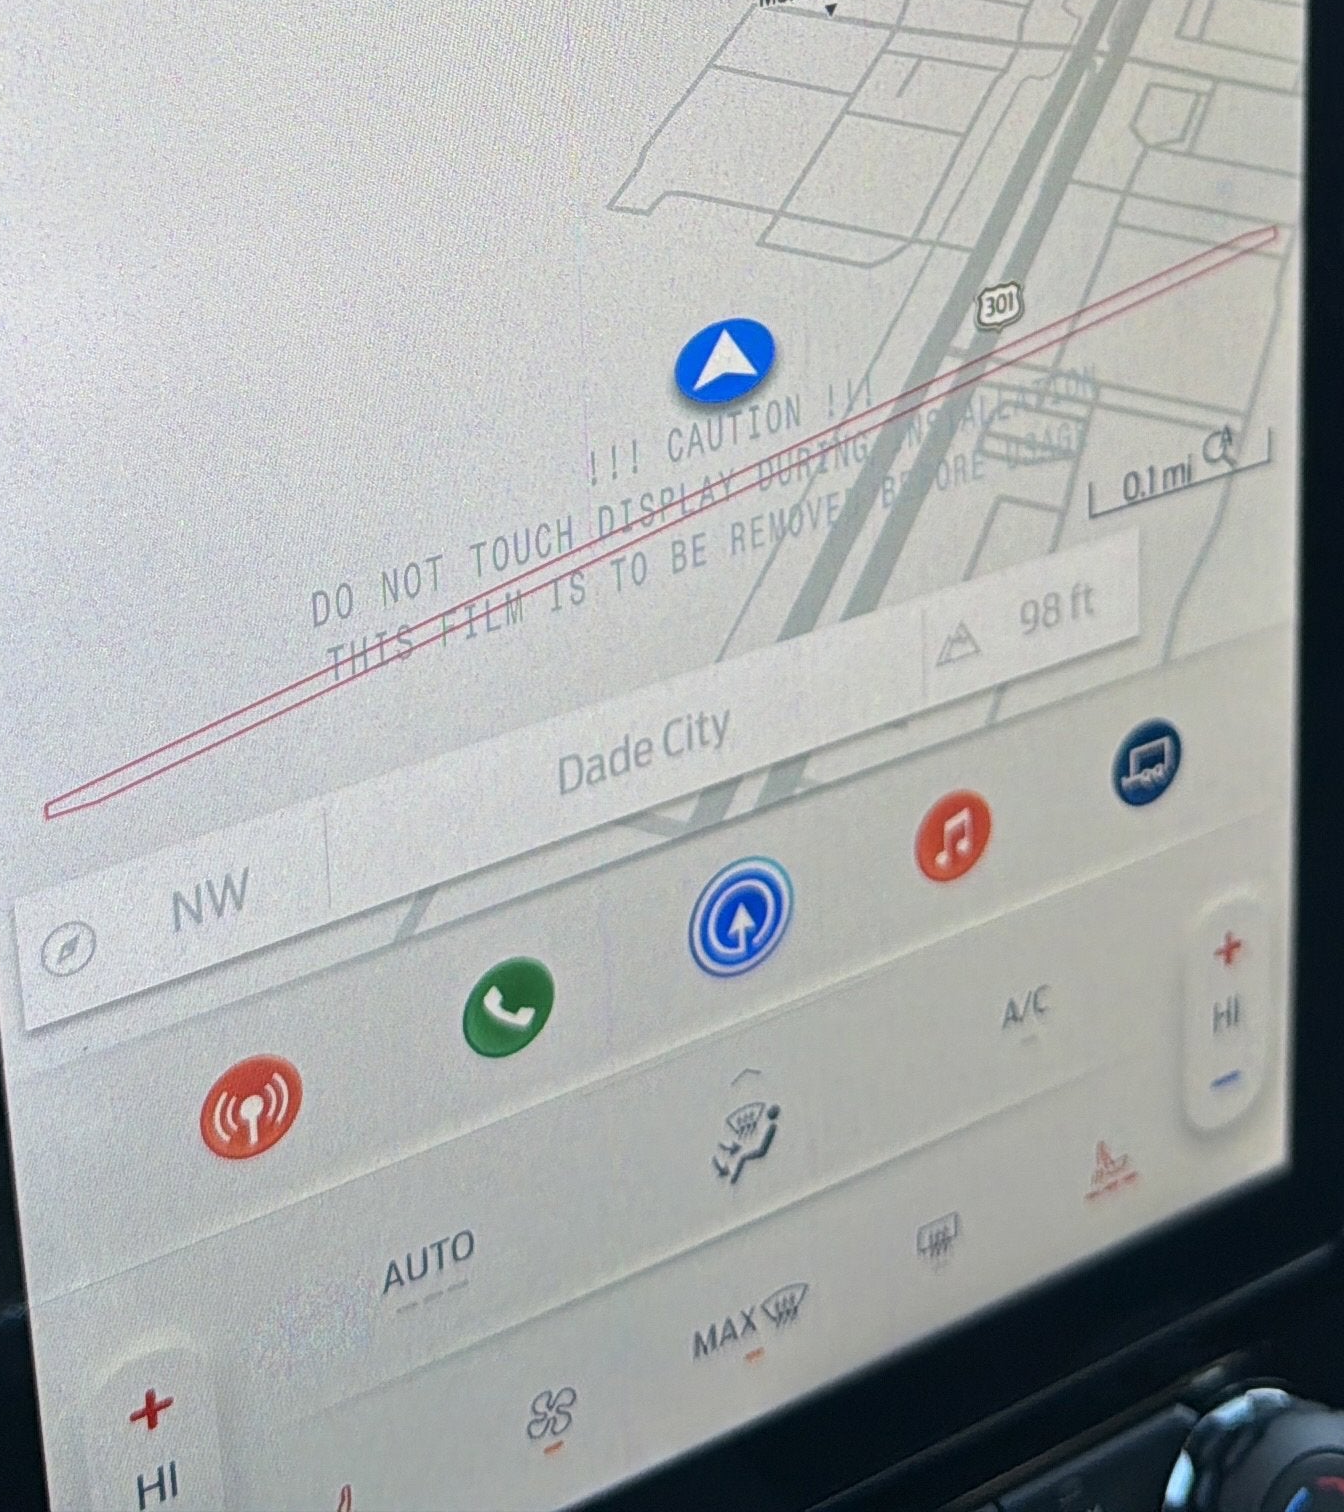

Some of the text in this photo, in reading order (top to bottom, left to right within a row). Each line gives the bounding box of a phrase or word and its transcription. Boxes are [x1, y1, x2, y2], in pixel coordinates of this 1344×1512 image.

[984, 291, 1016, 319] 301
[667, 394, 802, 464] CAUTION
[1122, 453, 1193, 502] 0.1 mi
[311, 582, 354, 628] DO
[381, 554, 444, 607] NOT
[469, 515, 575, 578] TOUCH
[598, 467, 736, 538] DISPLAY
[758, 432, 871, 493] DURING
[326, 624, 414, 682] THIS
[440, 589, 524, 648] FILM
[550, 571, 587, 612] IS
[610, 550, 648, 592] TO
[671, 531, 707, 574] BE
[730, 488, 859, 556] REMOVE
[1019, 582, 1096, 638] 98 ft
[557, 706, 732, 795] Dade City
[171, 866, 251, 934] NW
[1002, 984, 1052, 1031] A/C
[1212, 995, 1240, 1035] HI
[382, 1228, 477, 1295] AUTO
[692, 1305, 758, 1361] MAX
[136, 1460, 179, 1511] HI
